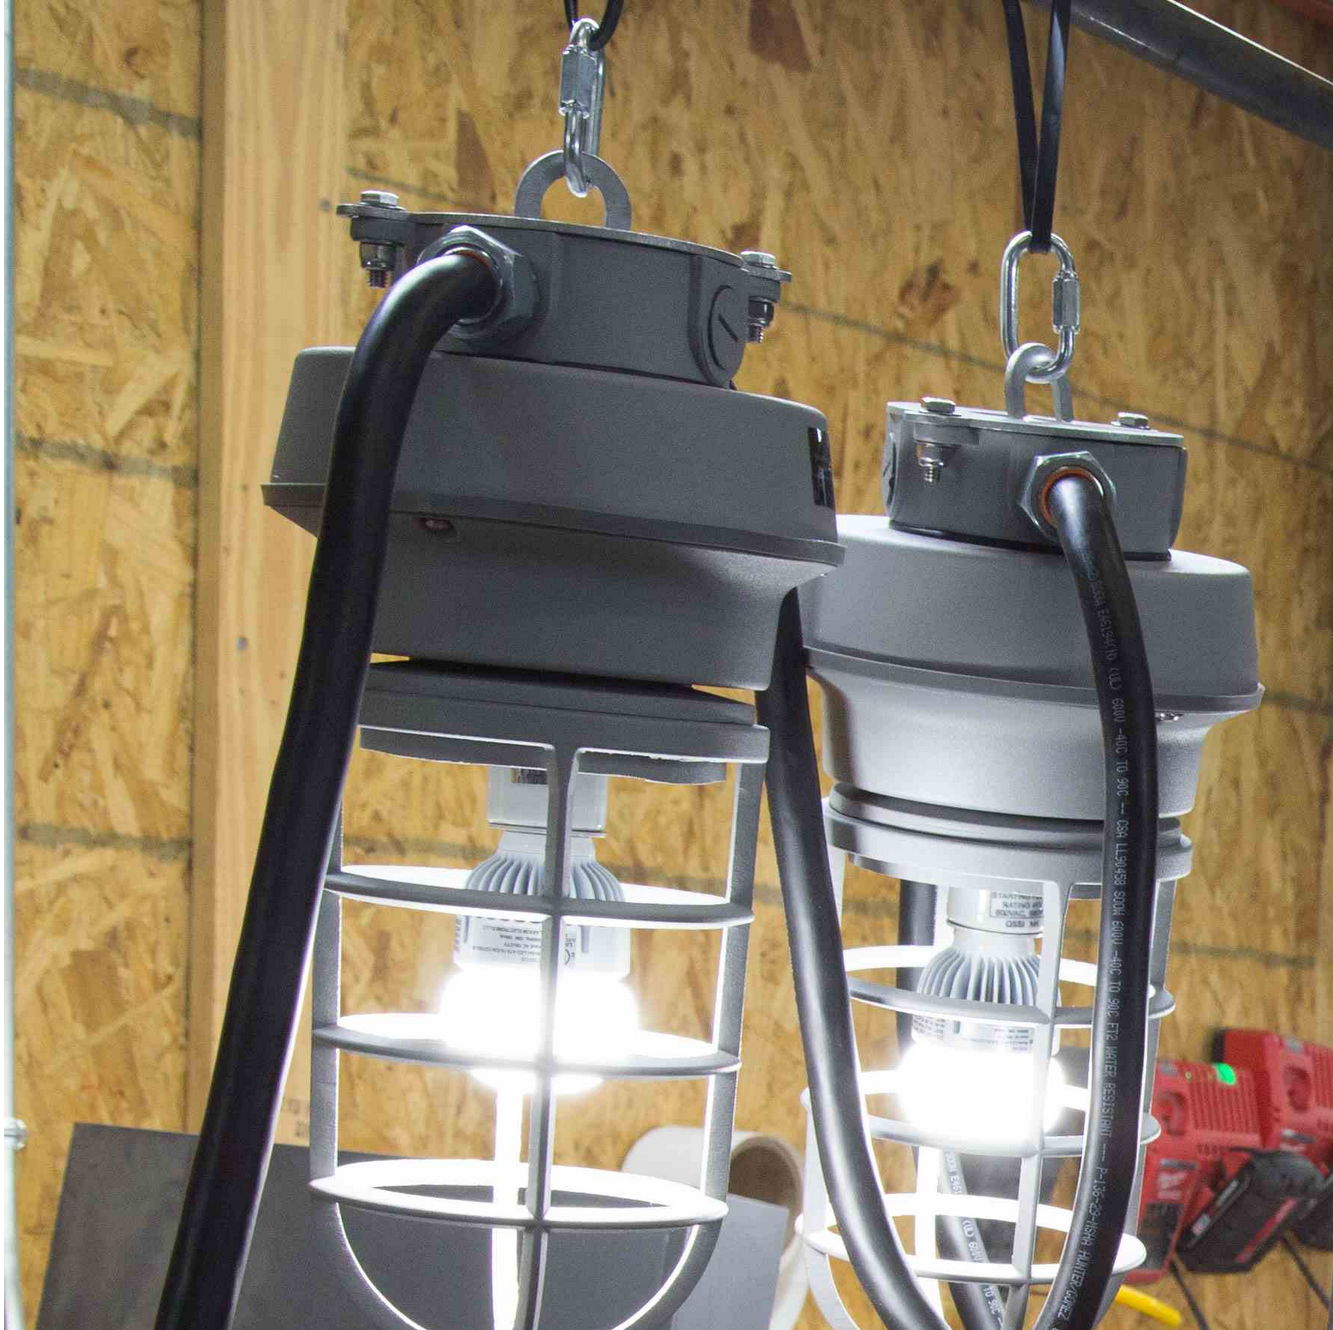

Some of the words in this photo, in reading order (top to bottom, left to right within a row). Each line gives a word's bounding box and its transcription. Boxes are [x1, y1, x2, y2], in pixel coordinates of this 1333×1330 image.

[1111, 697, 1127, 723] 600V
[1115, 759, 1128, 773] TO
[1115, 776, 1129, 797] 90C
[1115, 819, 1129, 838] CSA
[1110, 920, 1125, 945] 600V
[1108, 949, 1122, 975] -40C
[1107, 980, 1122, 993] TO
[1106, 998, 1120, 1017] 90C
[1108, 1021, 1120, 1041] FT2
[1103, 1045, 1119, 1077] WATER
[1099, 1082, 1117, 1138] RESISTANT
